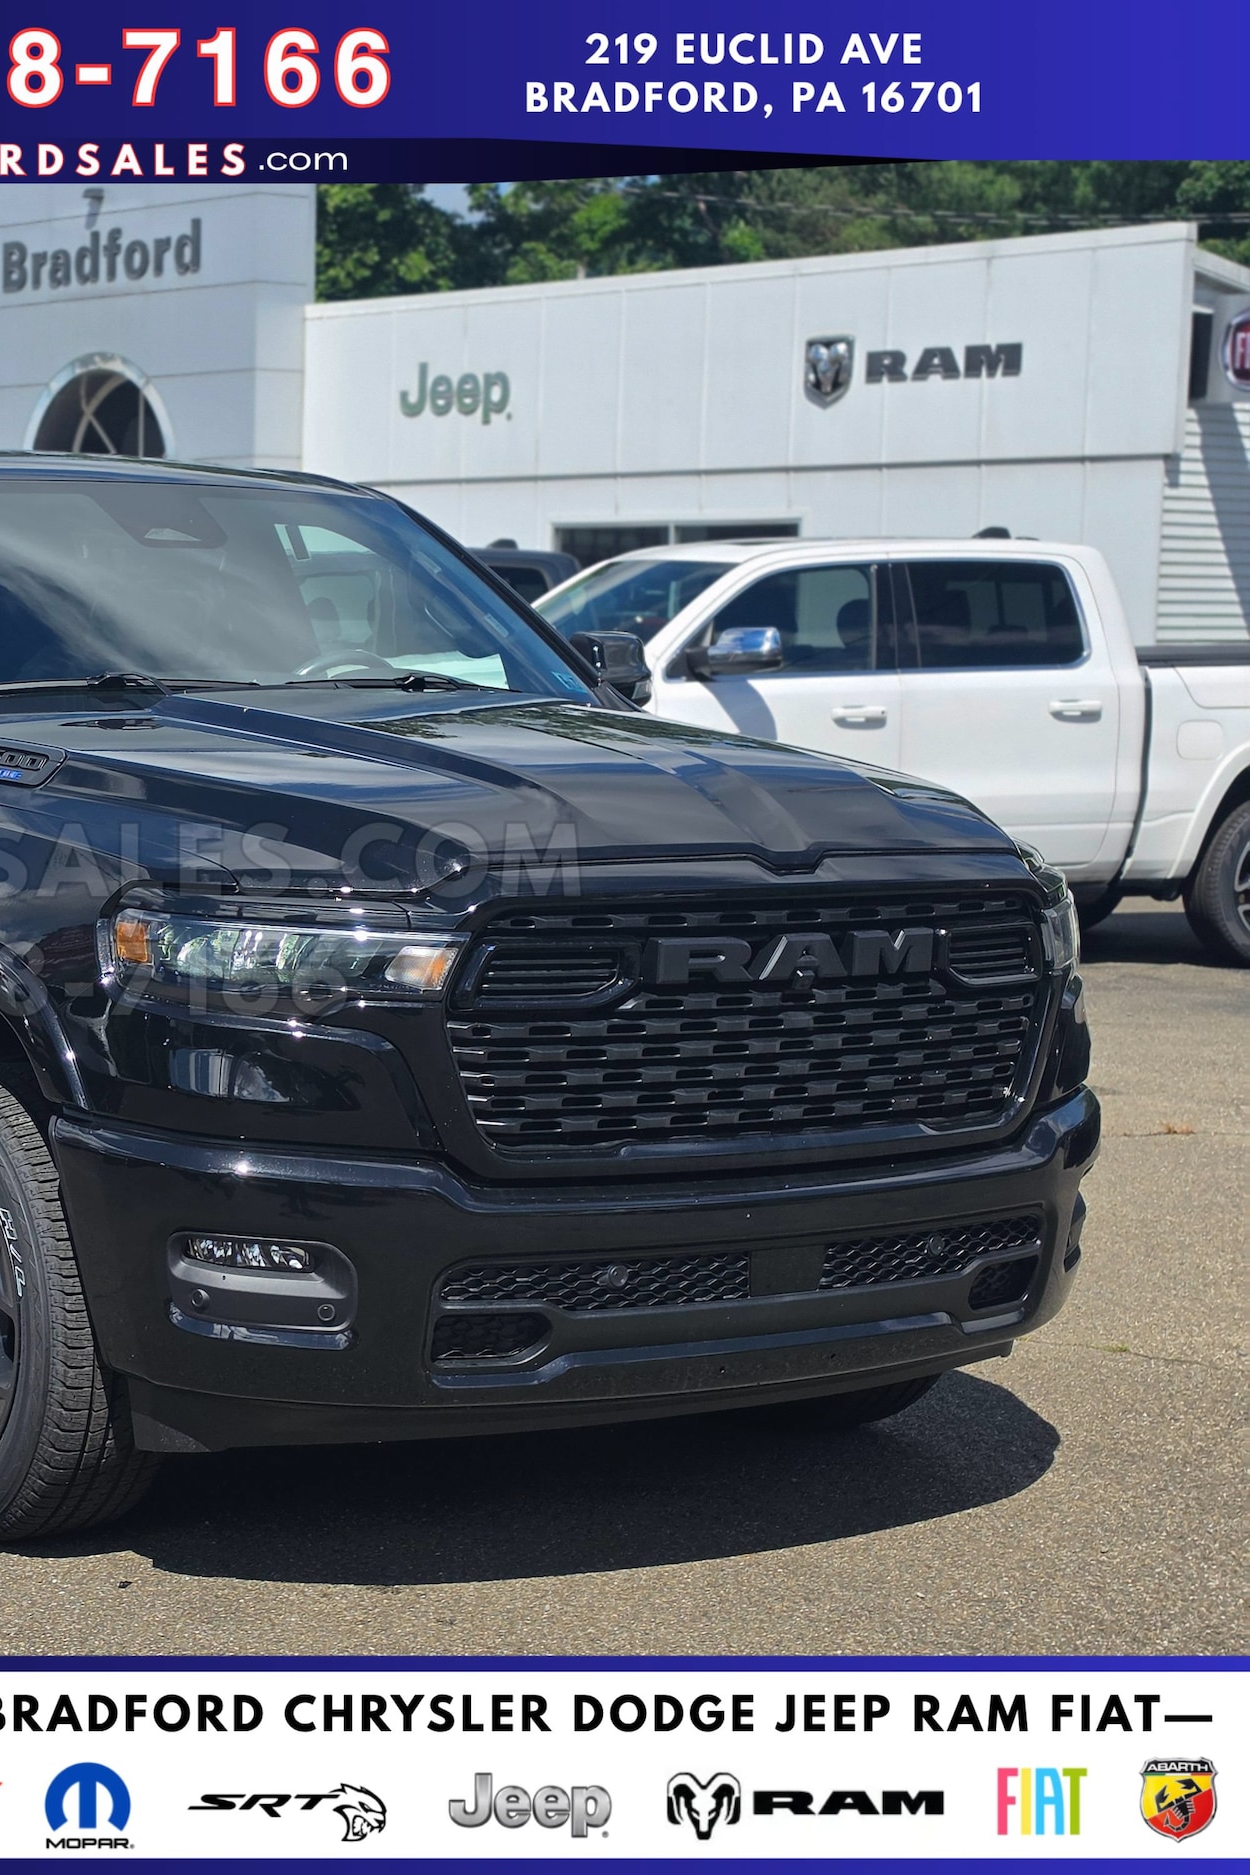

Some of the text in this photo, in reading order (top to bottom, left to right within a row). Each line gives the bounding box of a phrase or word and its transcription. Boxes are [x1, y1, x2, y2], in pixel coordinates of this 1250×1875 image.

[2, 217, 202, 293] Bradford
[399, 362, 512, 425] Jeep
[865, 342, 1023, 385] RAM
[655, 927, 935, 985] RAM
